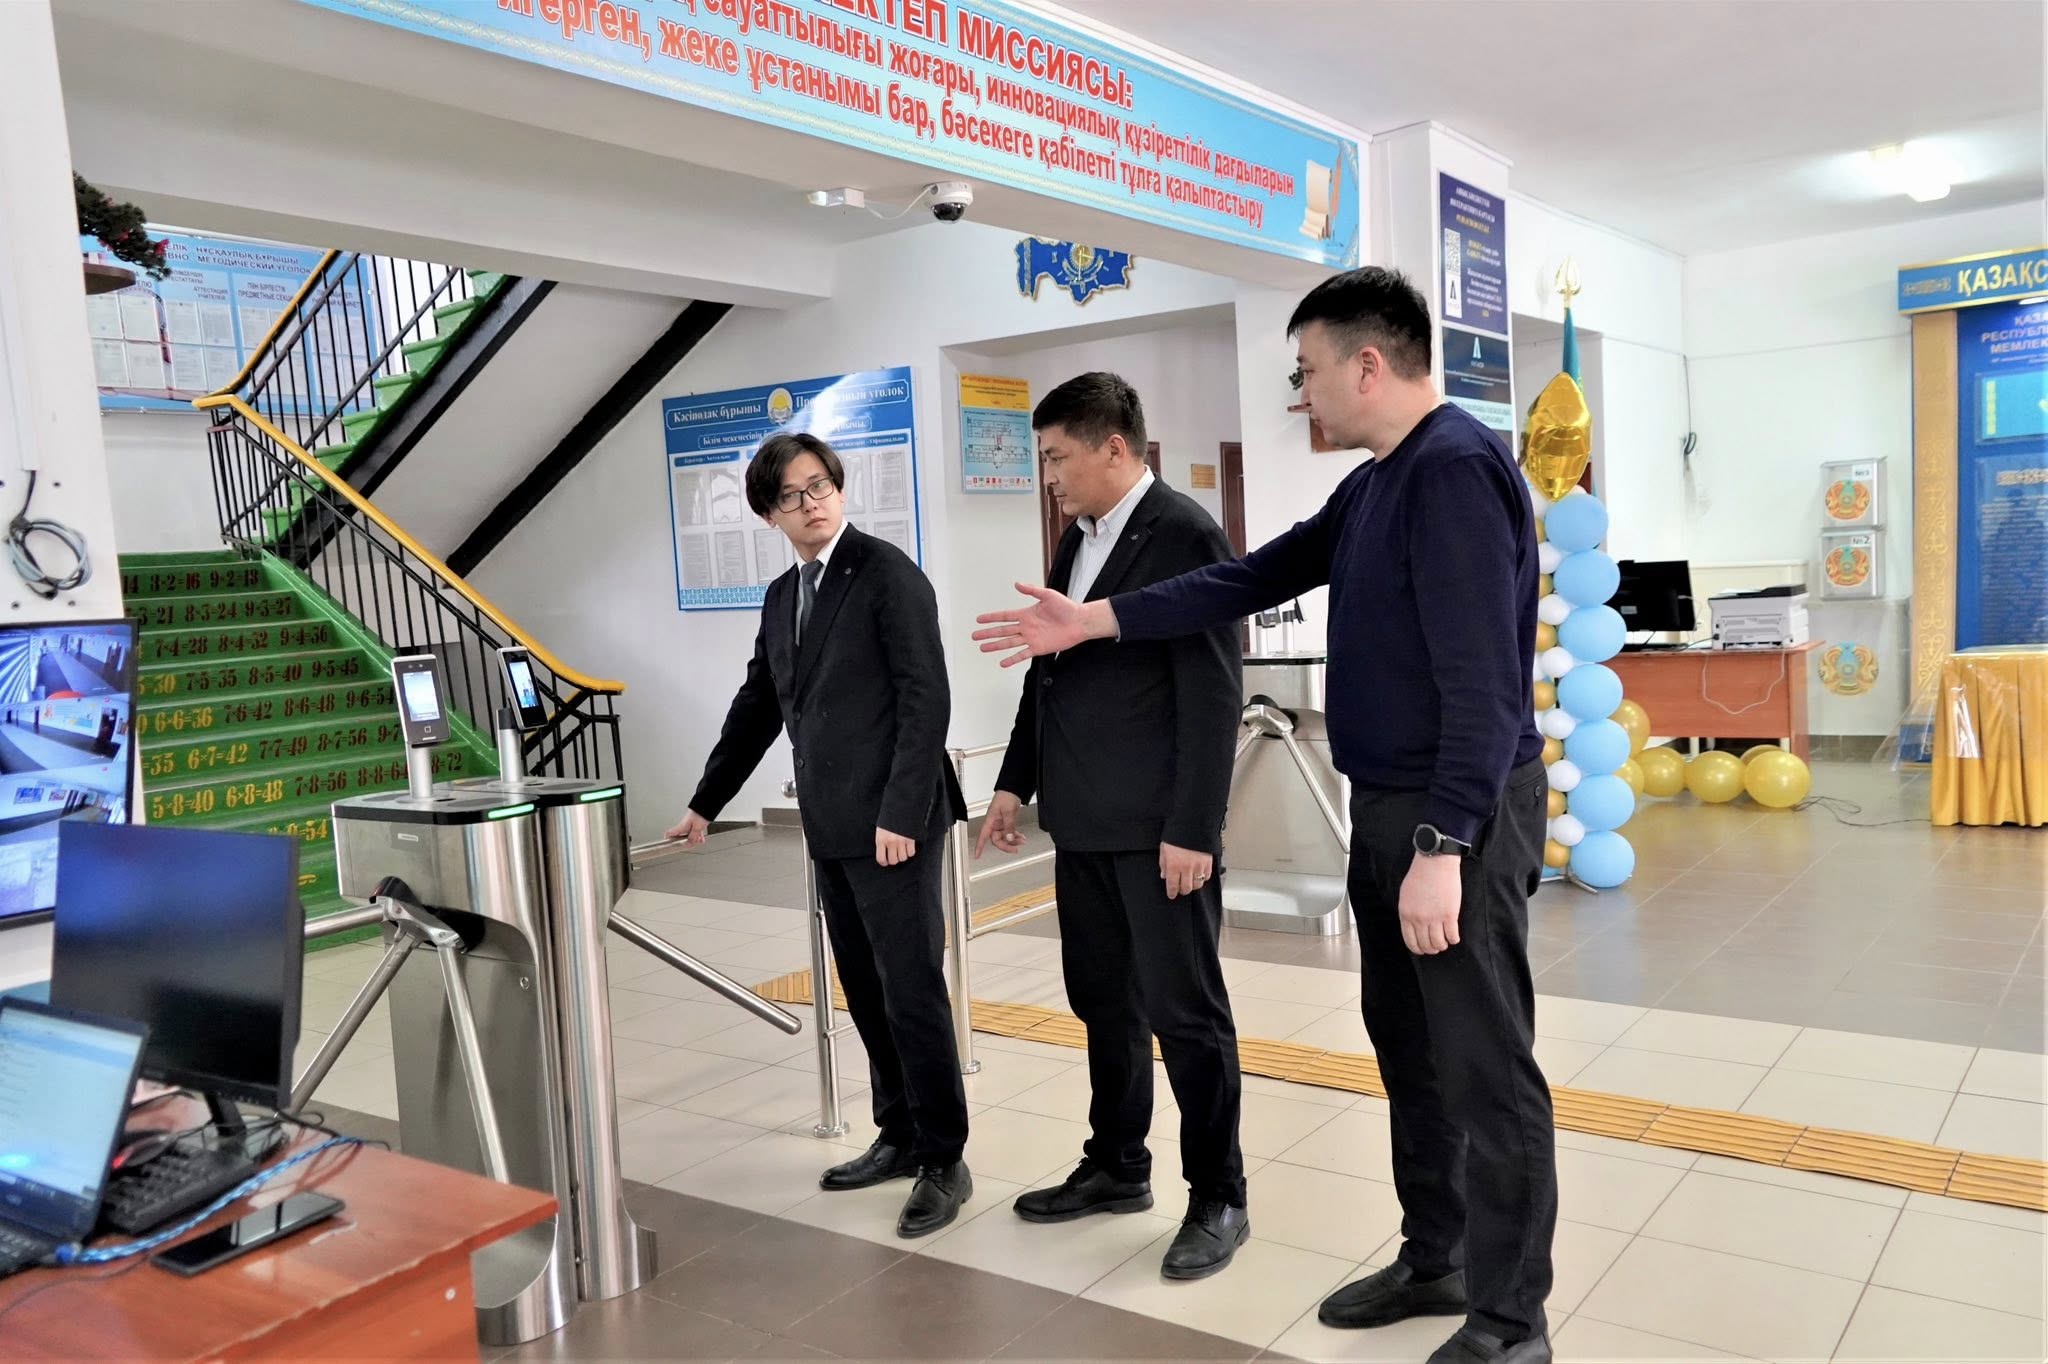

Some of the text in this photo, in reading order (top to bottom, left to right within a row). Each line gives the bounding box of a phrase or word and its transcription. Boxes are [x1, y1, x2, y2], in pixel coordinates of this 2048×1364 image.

[657, 17, 740, 76] жеке
[744, 45, 882, 117] ұстанымы
[888, 80, 936, 142] бар,
[941, 98, 1034, 159] бәсекеге
[1038, 134, 1116, 182] қабілетті
[1120, 160, 1162, 197] тұлға
[1164, 174, 1265, 231] қалыптастыру
[888, 40, 981, 106] жоғары,
[985, 73, 1121, 148] инновациялық
[1124, 122, 1211, 171] құзіреттілік
[1214, 151, 1295, 198] дағдыларын
[957, 7, 1133, 111] МИССИЯСЫ:
[197, 255, 275, 271] МЕТОДИЧЕСКИЙ
